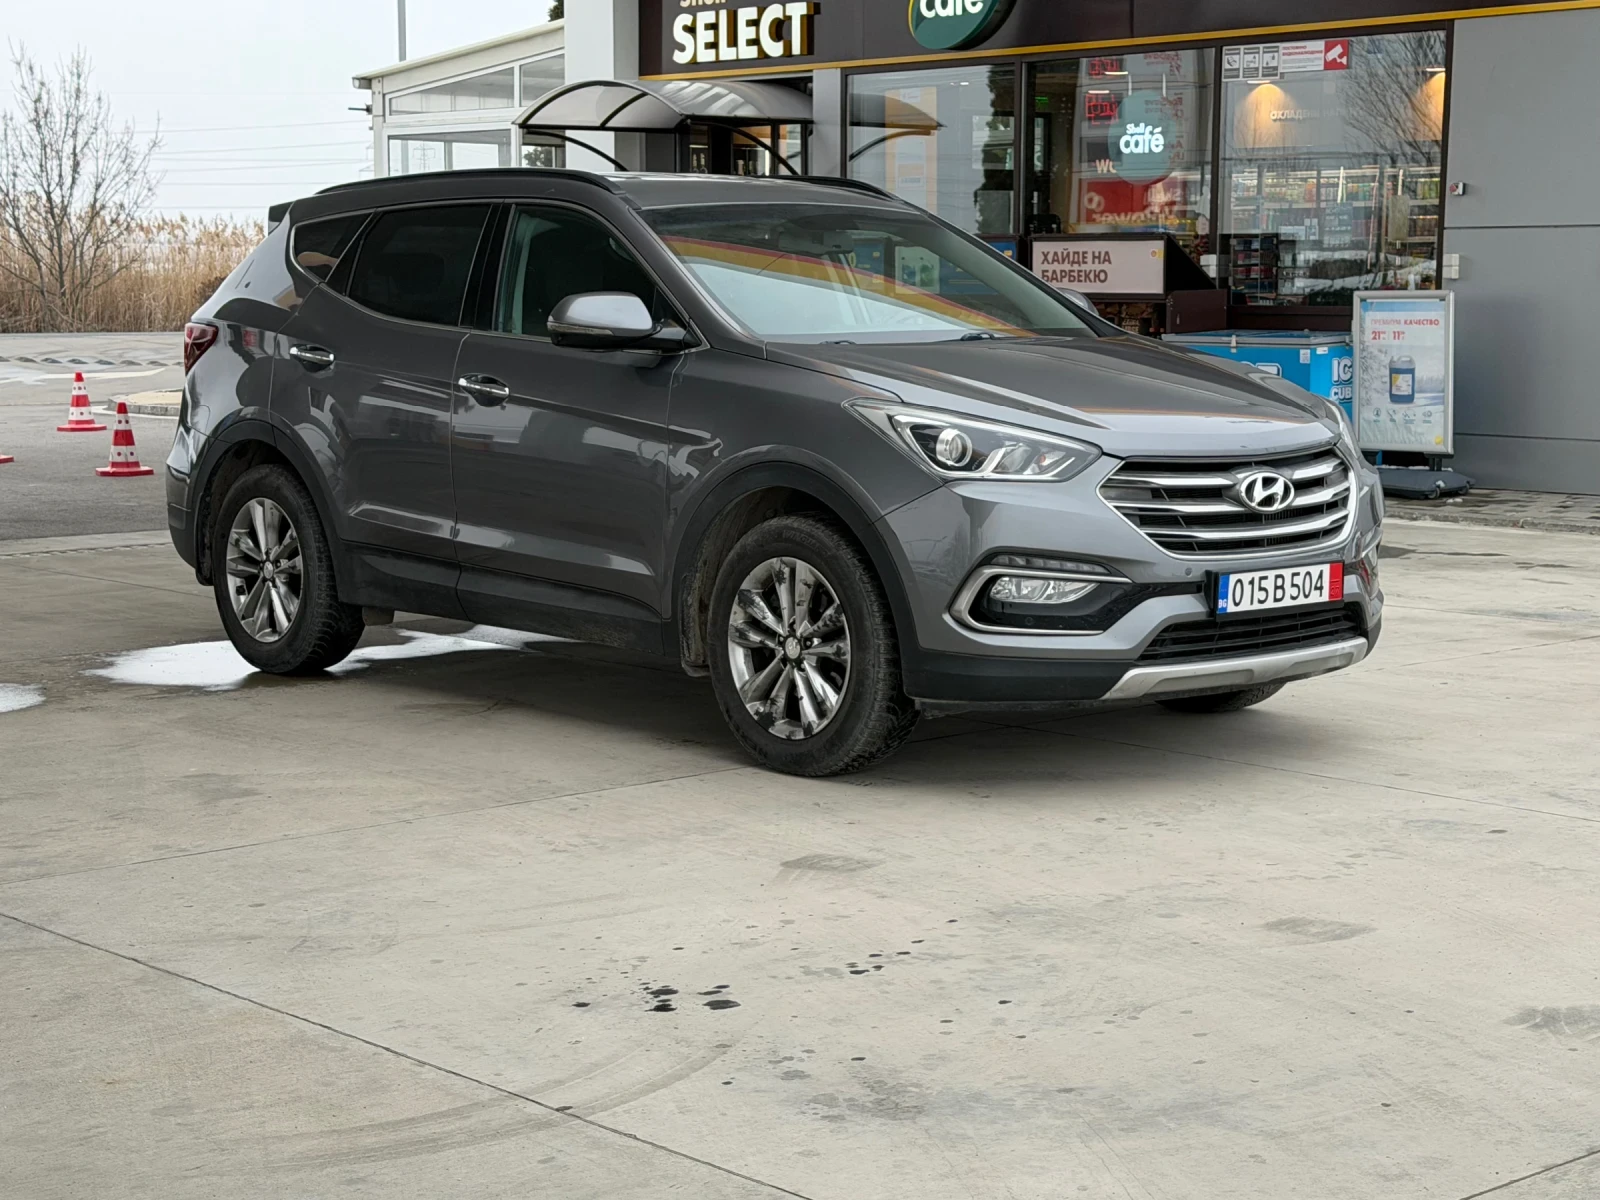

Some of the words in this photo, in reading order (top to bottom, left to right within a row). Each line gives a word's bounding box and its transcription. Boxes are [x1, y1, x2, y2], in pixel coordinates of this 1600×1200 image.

[672, 2, 807, 64] SELECT
[1120, 126, 1164, 153] café
[1041, 248, 1088, 267] ХАЙДЕ
[1092, 251, 1111, 265] НА
[1041, 269, 1108, 283] БАРБЕКЮ
[1218, 599, 1228, 608] BG
